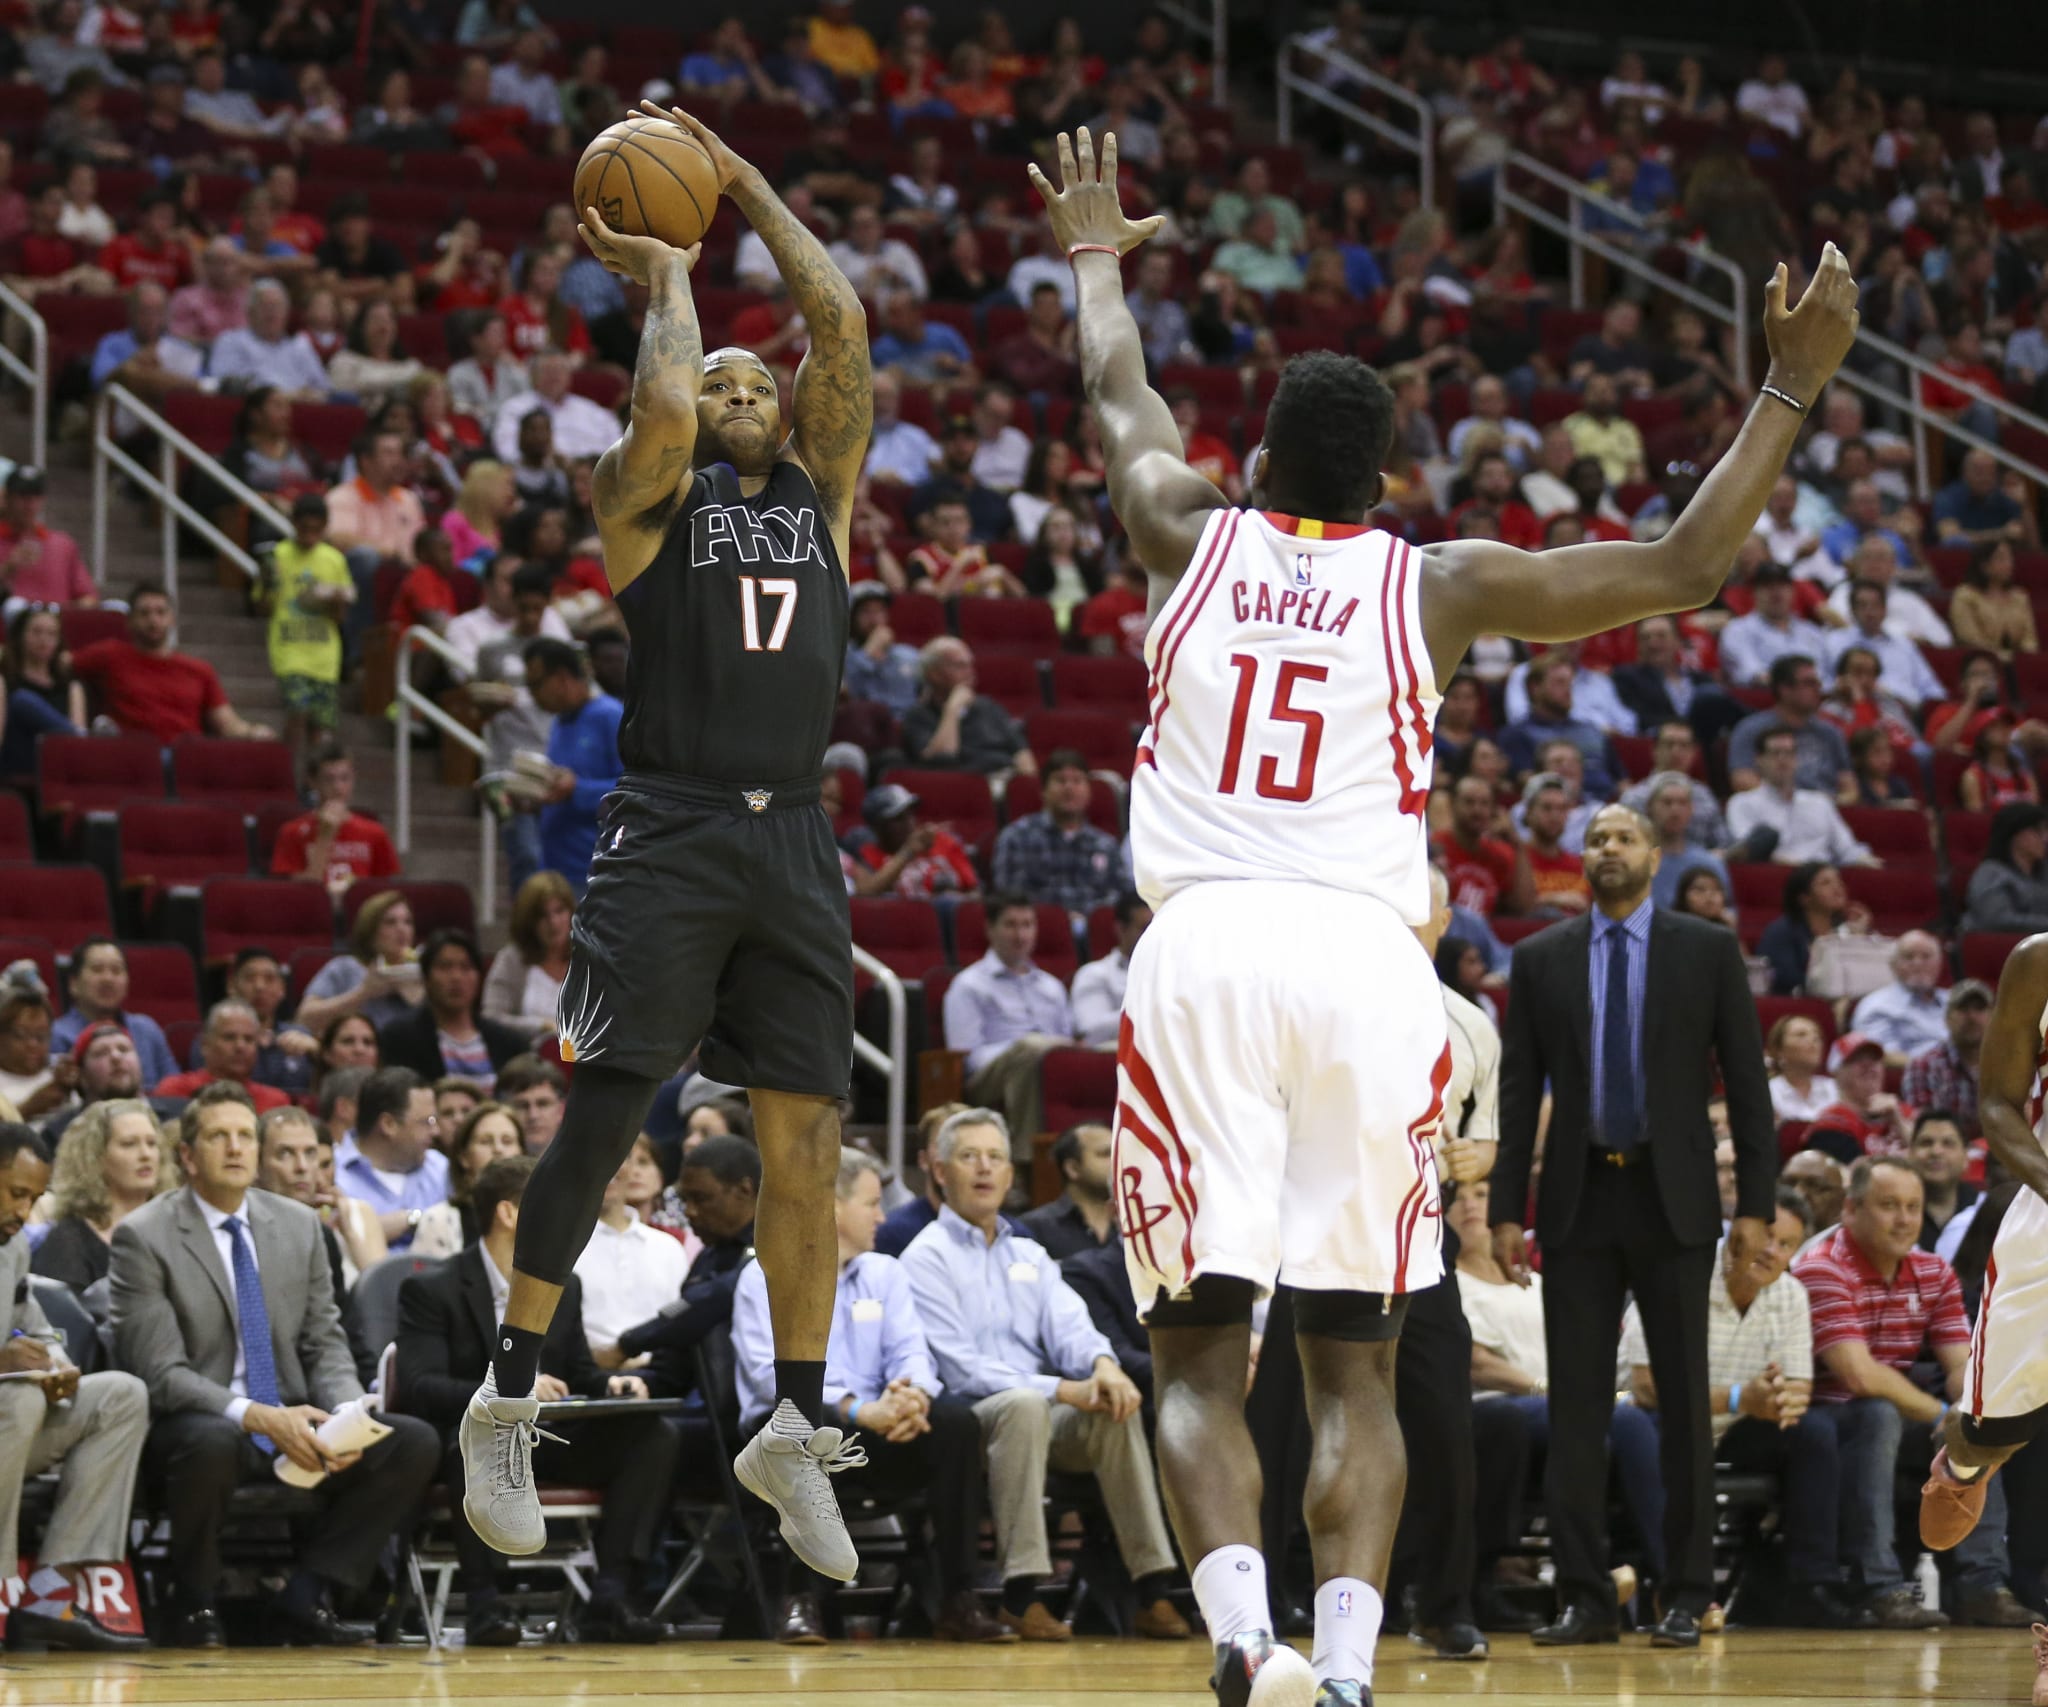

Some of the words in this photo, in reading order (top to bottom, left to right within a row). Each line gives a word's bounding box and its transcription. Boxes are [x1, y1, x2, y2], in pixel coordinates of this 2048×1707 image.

[689, 504, 828, 569] PHX
[738, 576, 799, 652] 17
[1232, 580, 1361, 637] CAPELA
[1217, 653, 1330, 803] 15
